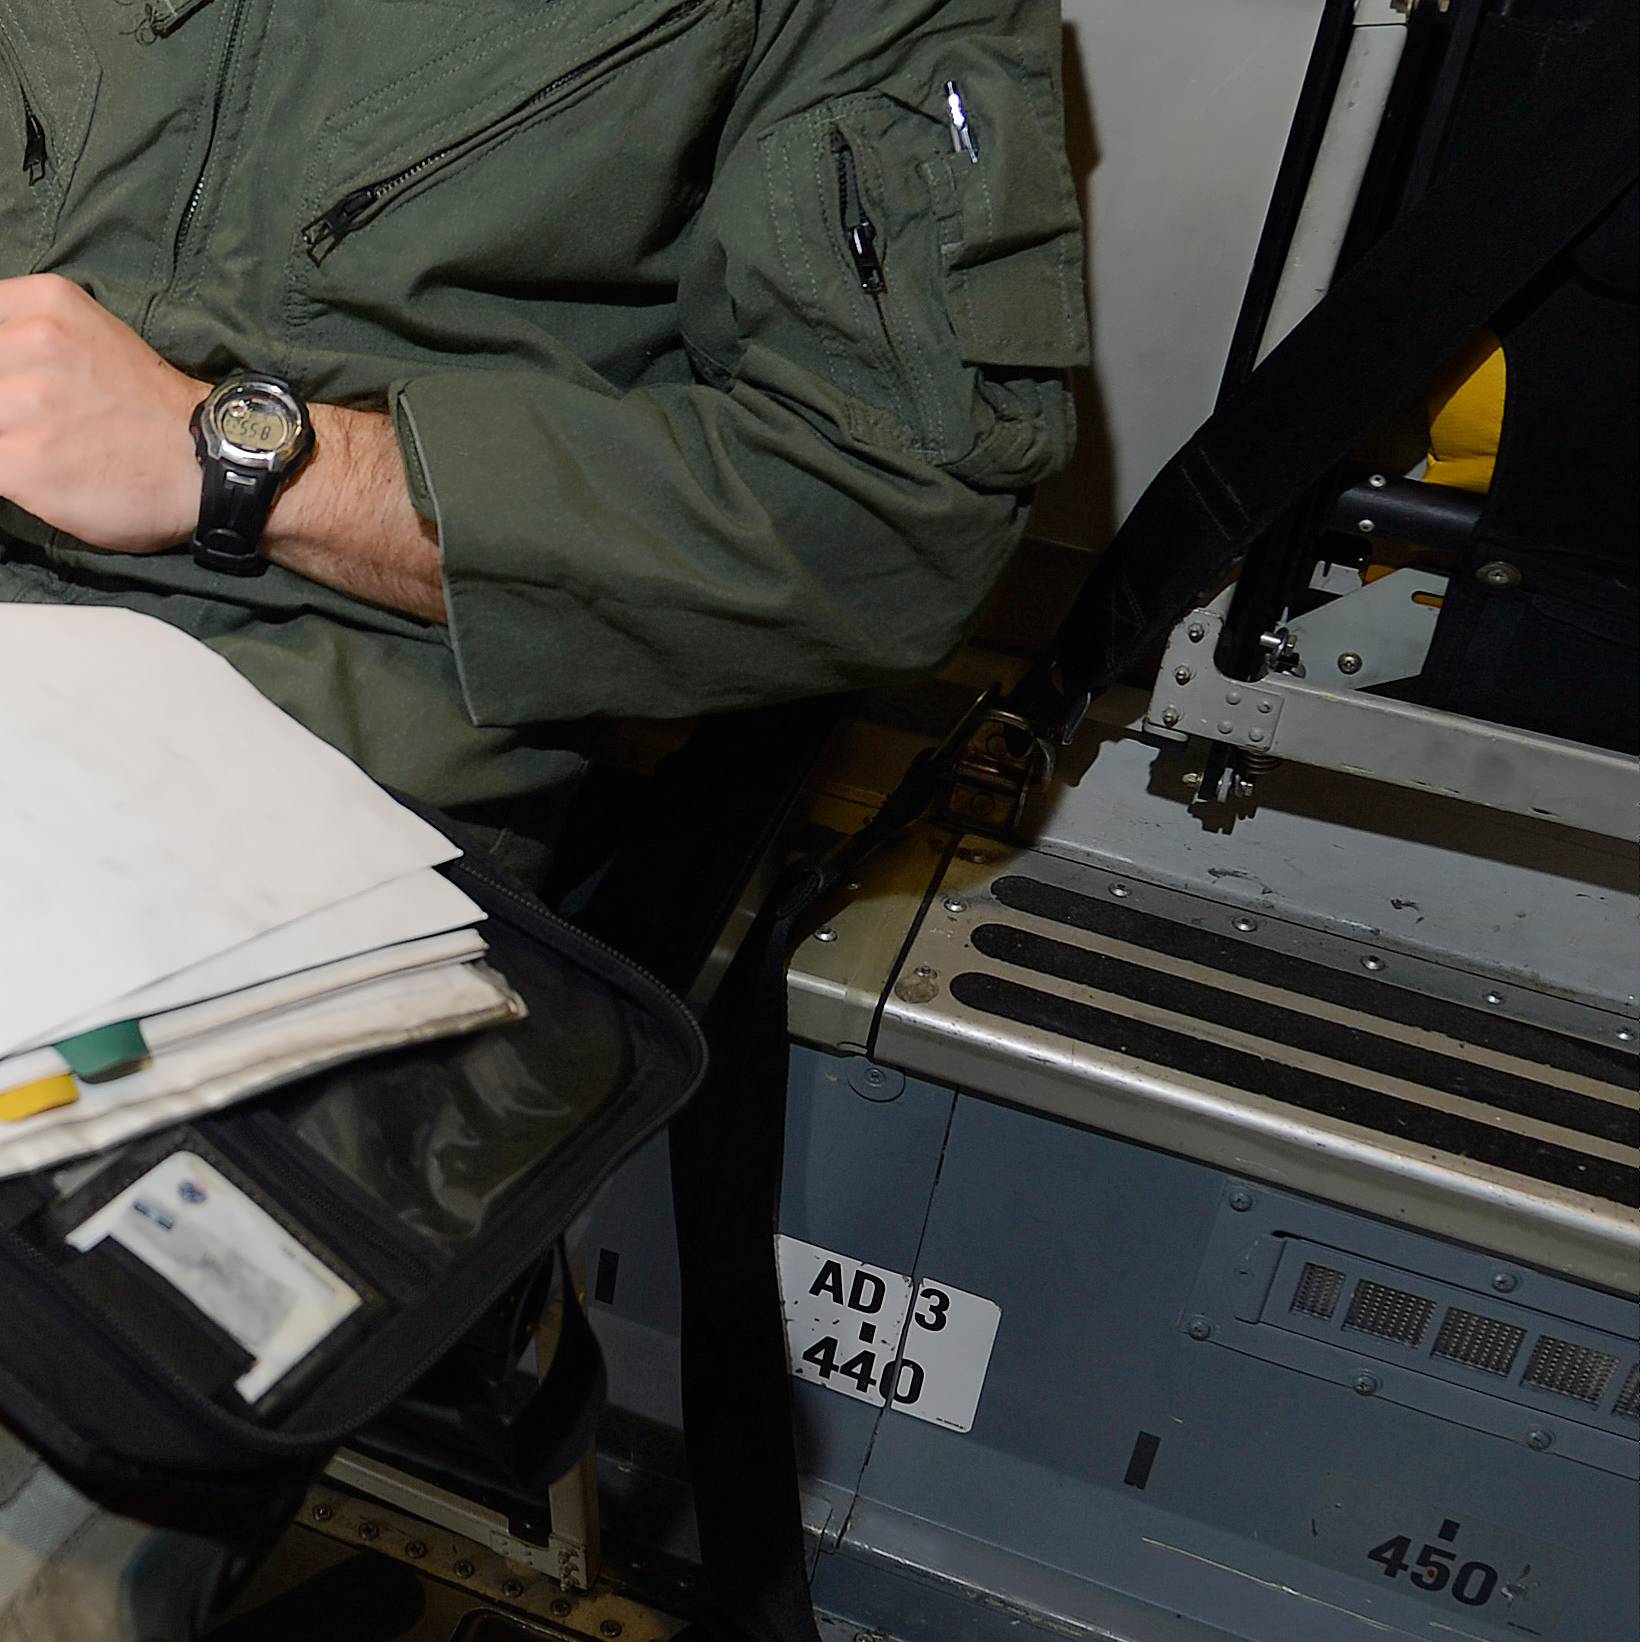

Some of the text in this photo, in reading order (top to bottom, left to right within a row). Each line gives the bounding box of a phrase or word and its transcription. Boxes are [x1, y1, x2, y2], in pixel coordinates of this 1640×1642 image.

[808, 1259, 951, 1333] AD 3
[801, 1335, 926, 1406] 440
[1366, 1534, 1500, 1607] 450
